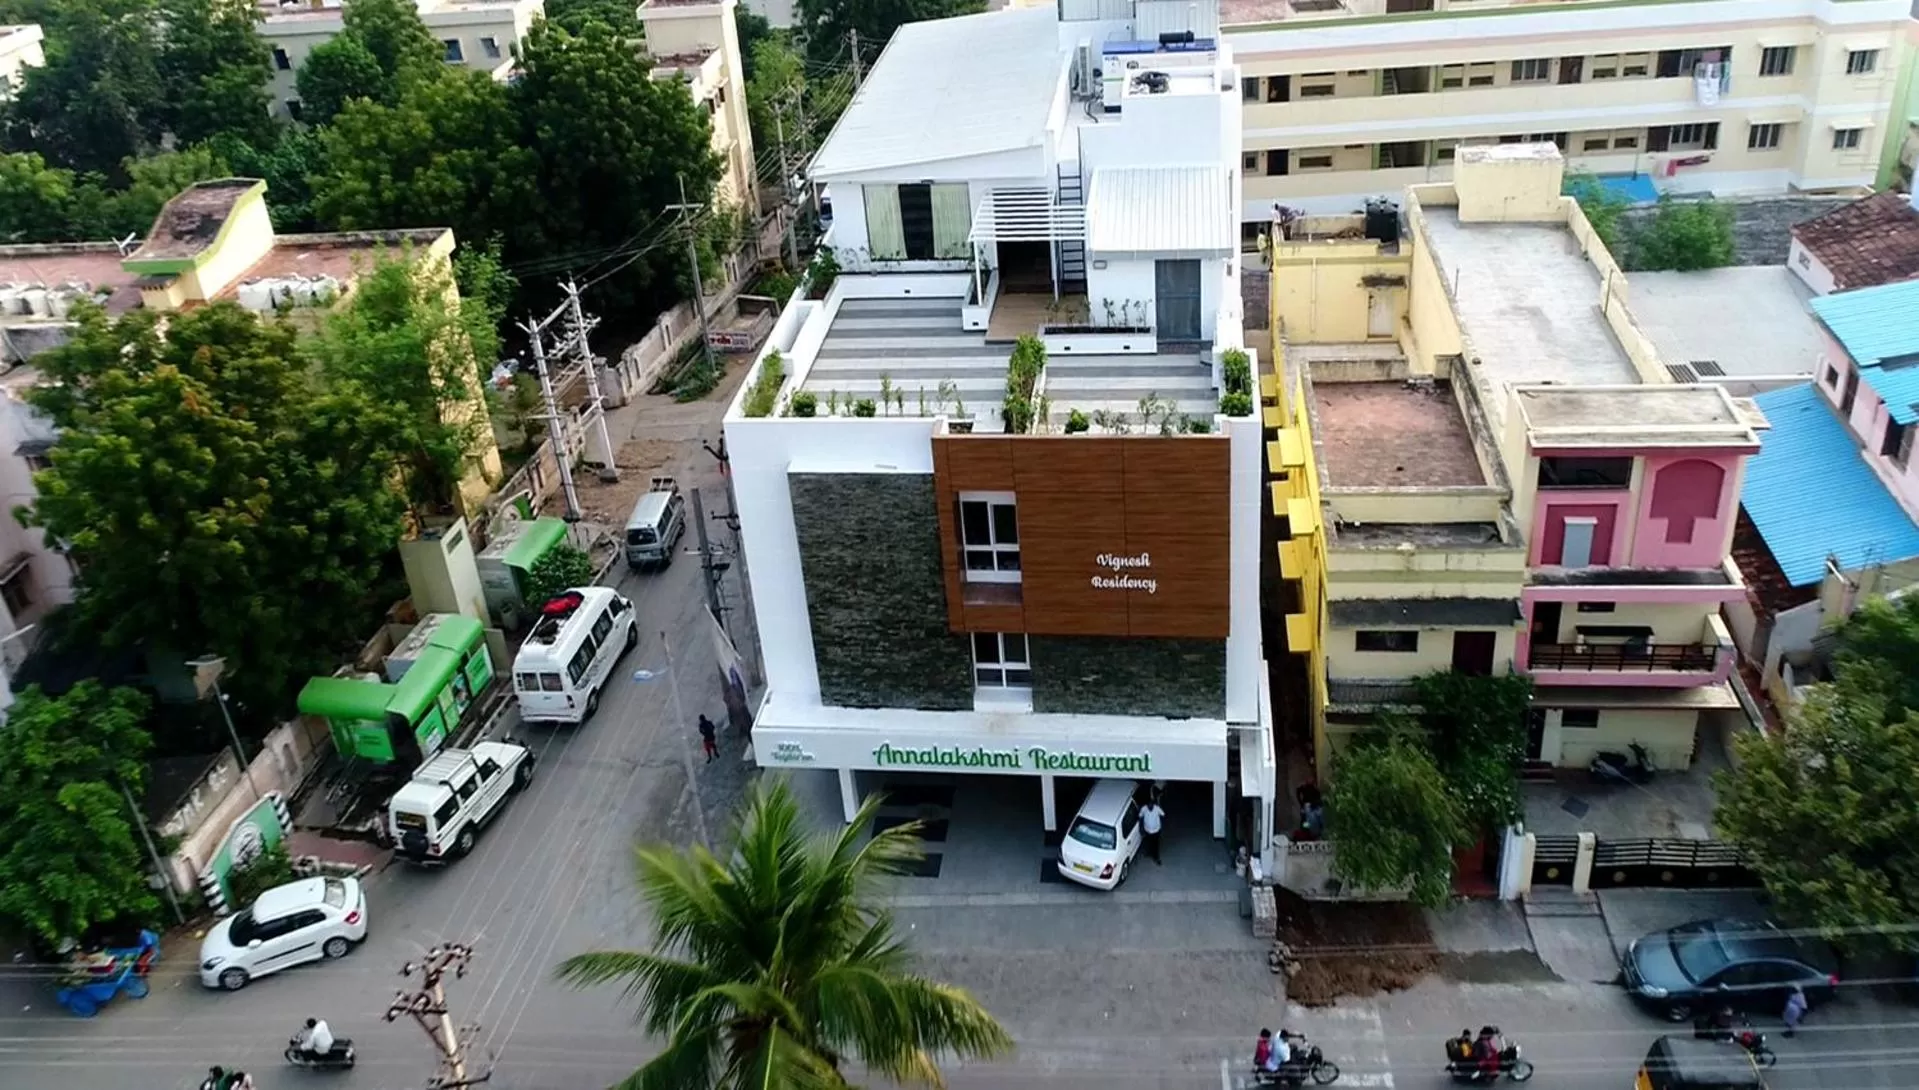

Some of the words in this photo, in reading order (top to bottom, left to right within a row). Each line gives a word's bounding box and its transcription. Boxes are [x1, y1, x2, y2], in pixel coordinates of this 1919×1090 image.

[1096, 552, 1151, 572] Vignesh
[1091, 574, 1157, 595] Residency
[872, 742, 1021, 768] Annalakshmi
[1028, 747, 1152, 772] Restaurant
